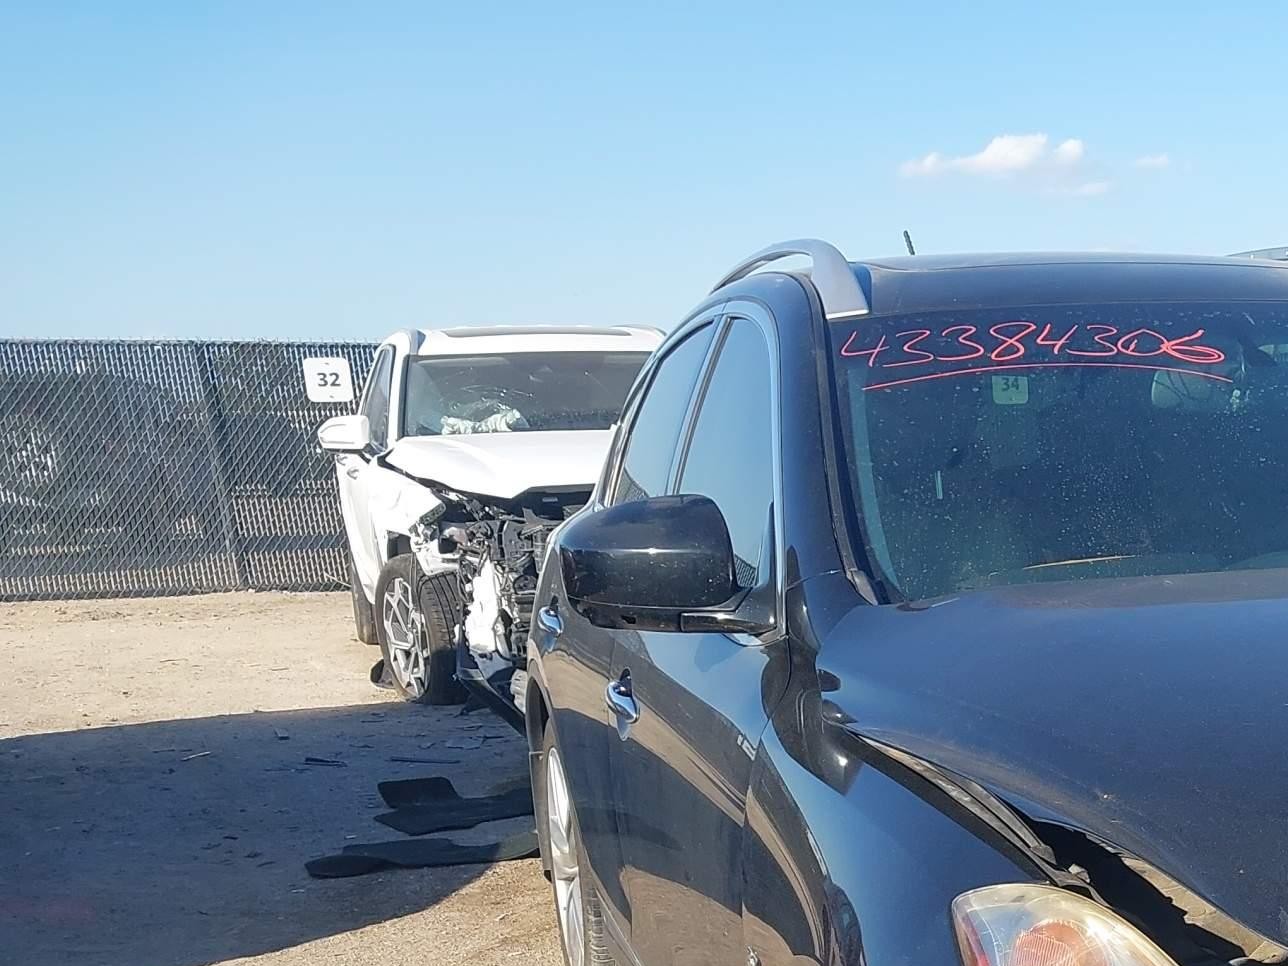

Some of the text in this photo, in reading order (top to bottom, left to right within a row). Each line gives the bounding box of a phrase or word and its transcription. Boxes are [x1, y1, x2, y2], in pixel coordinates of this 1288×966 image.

[841, 321, 1225, 367] 43384306
[316, 372, 341, 387] 32
[1001, 378, 1020, 391] 34
